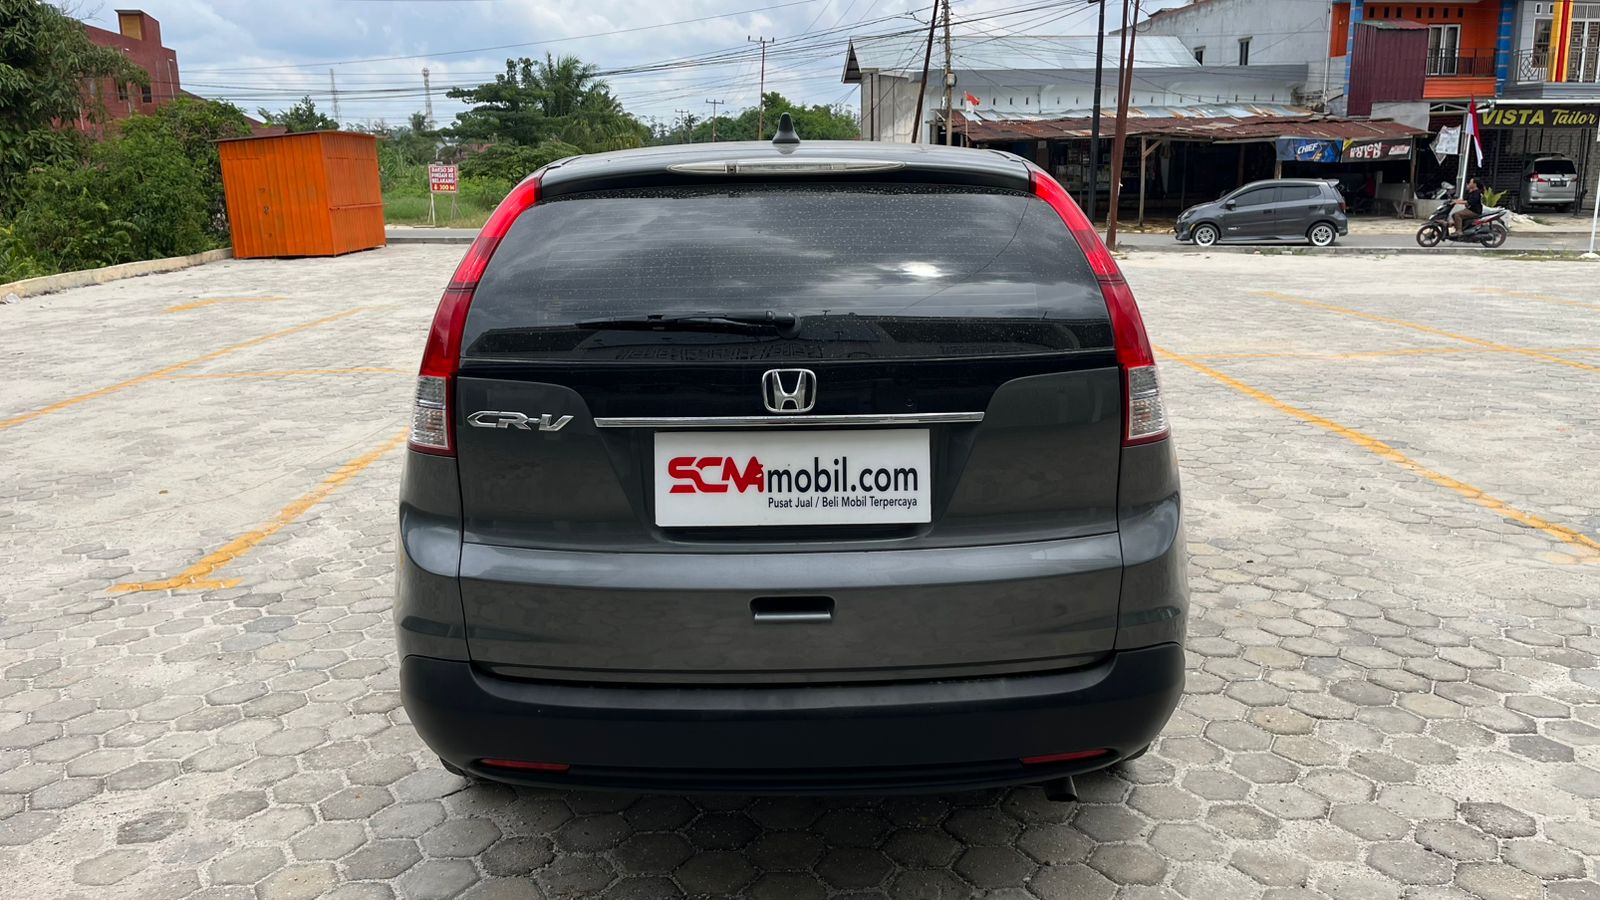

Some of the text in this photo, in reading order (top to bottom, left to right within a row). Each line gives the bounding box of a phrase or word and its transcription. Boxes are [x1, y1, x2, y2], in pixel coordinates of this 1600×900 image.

[1482, 109, 1597, 126] VISTA Tailor
[1297, 142, 1319, 154] CHIEF
[466, 410, 575, 432] CR-V
[768, 497, 793, 508] Pusat
[795, 496, 813, 508] Jual
[822, 496, 839, 507] Beli
[841, 496, 867, 507] Mobil
[870, 495, 918, 509] Terpercaya
